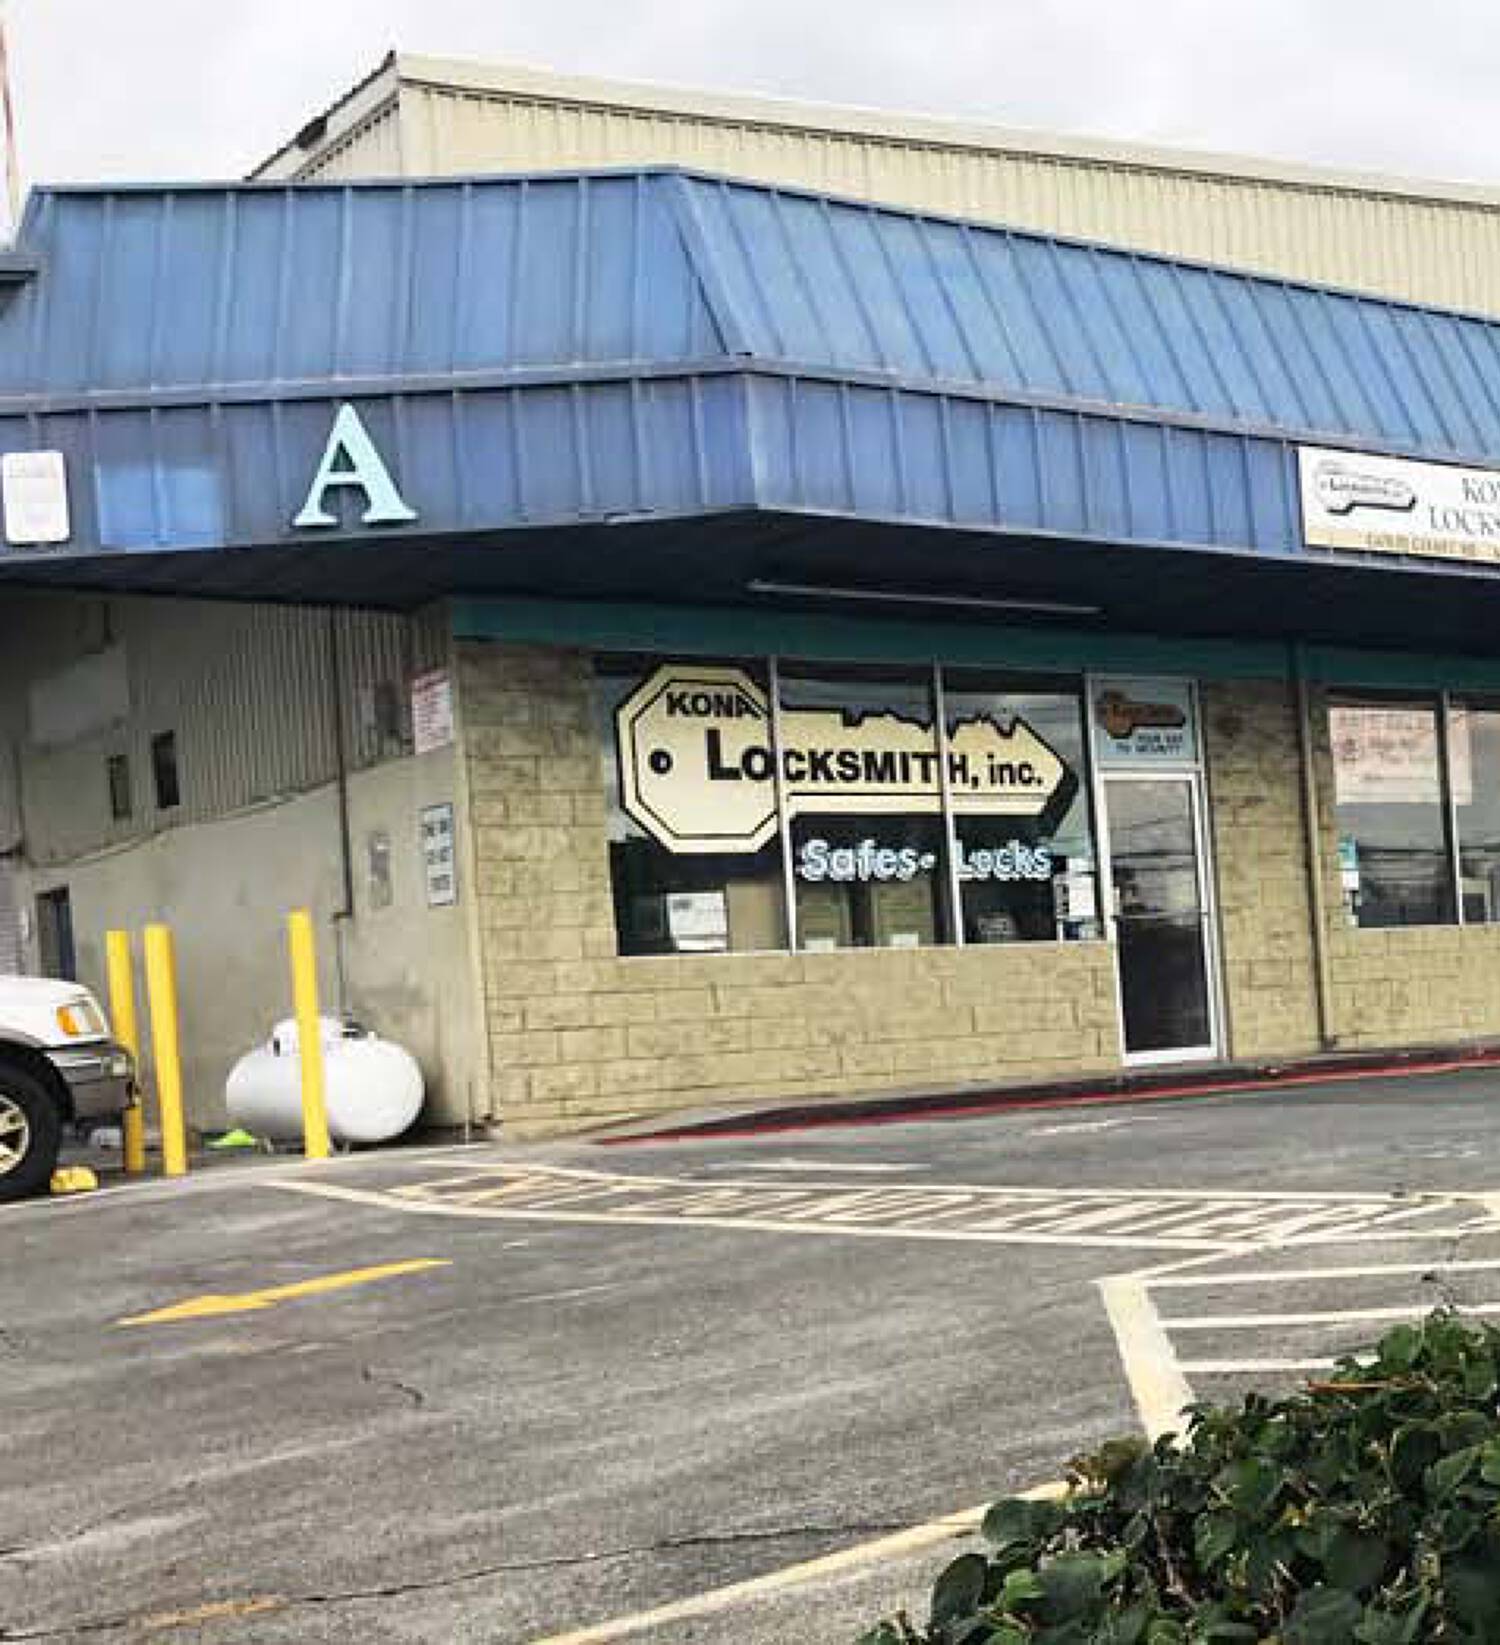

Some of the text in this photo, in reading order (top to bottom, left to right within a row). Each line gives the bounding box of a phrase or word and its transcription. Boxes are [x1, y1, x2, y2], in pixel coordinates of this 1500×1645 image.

[292, 402, 417, 527] A
[665, 691, 763, 720] KONA
[986, 754, 1044, 788] inc.
[799, 838, 1055, 883] Safes Locks
